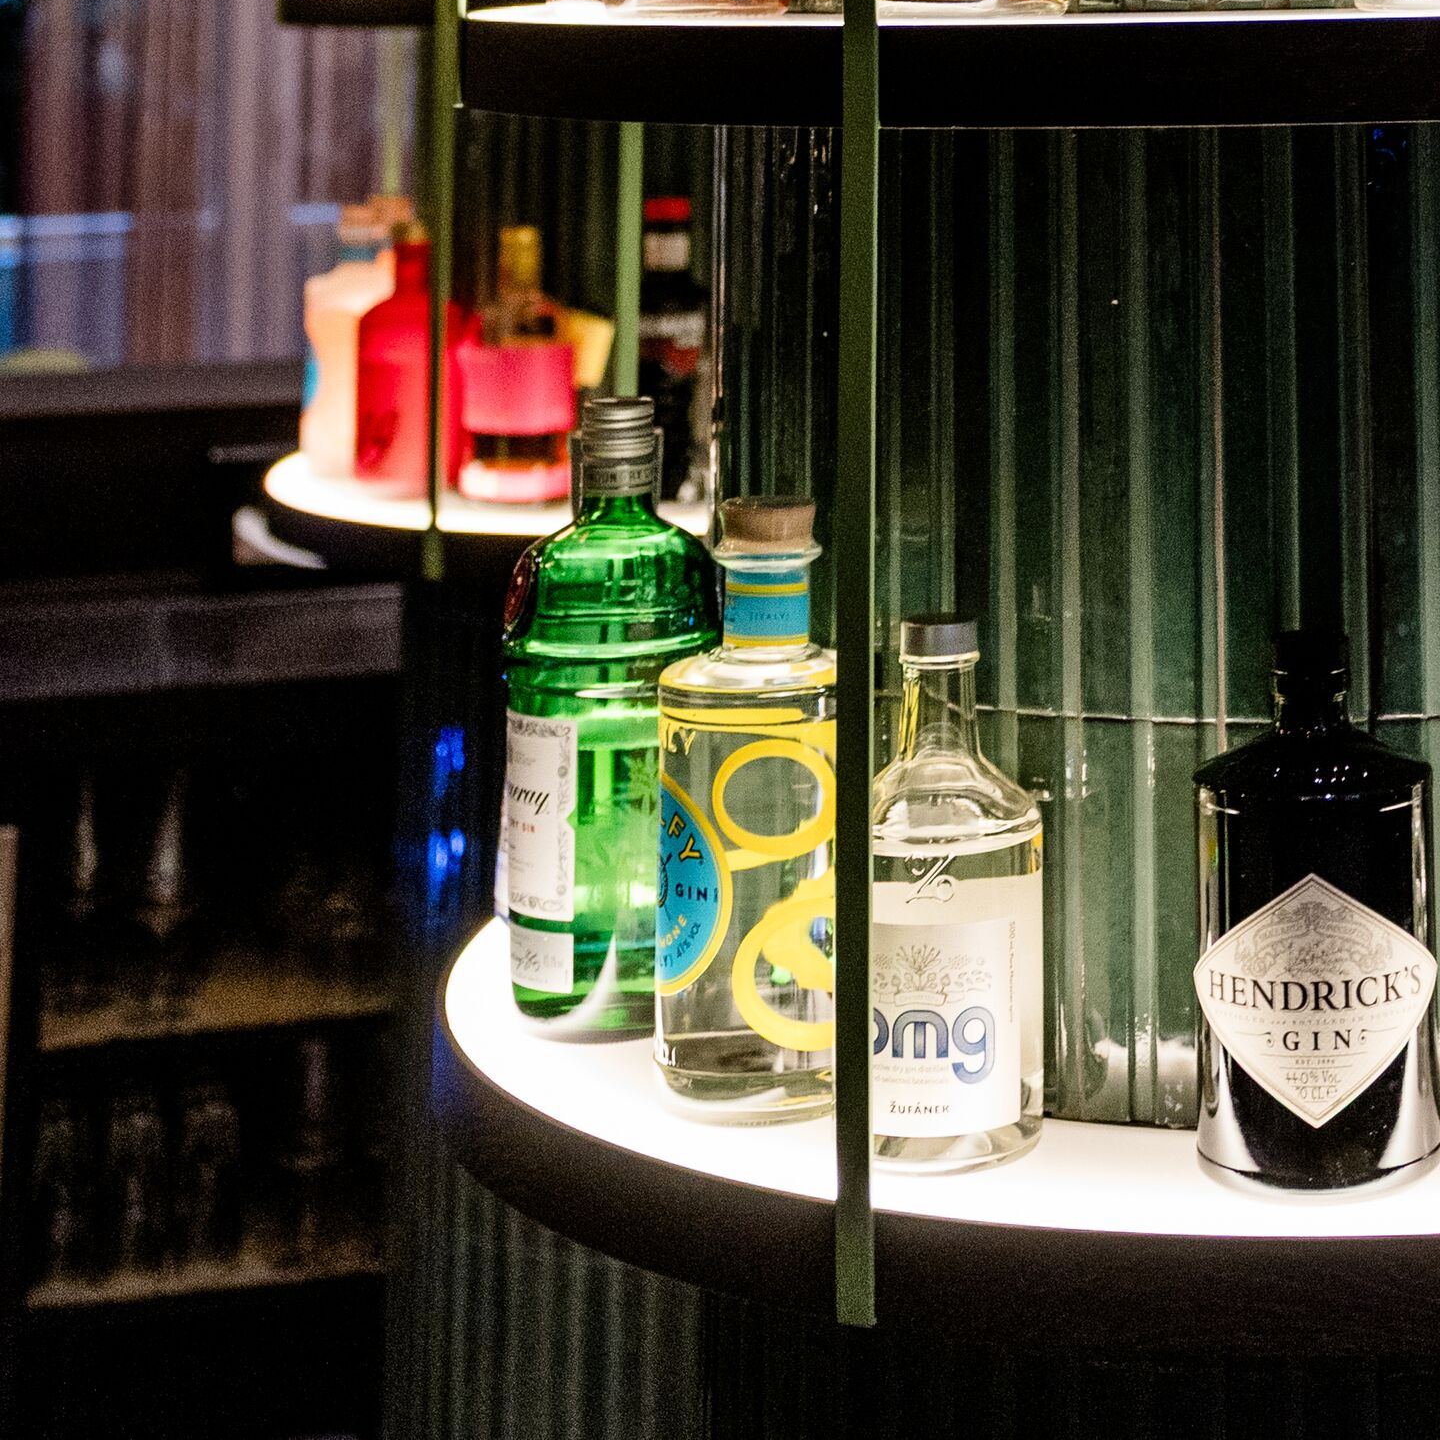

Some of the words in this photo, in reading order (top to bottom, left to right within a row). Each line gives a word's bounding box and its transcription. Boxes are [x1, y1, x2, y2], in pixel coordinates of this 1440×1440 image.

[675, 882, 709, 903] GIN
[1208, 964, 1423, 1012] HENDRICK'S
[1282, 1029, 1352, 1051] GIN
[889, 1099, 951, 1116] ŽUFÁNEK
